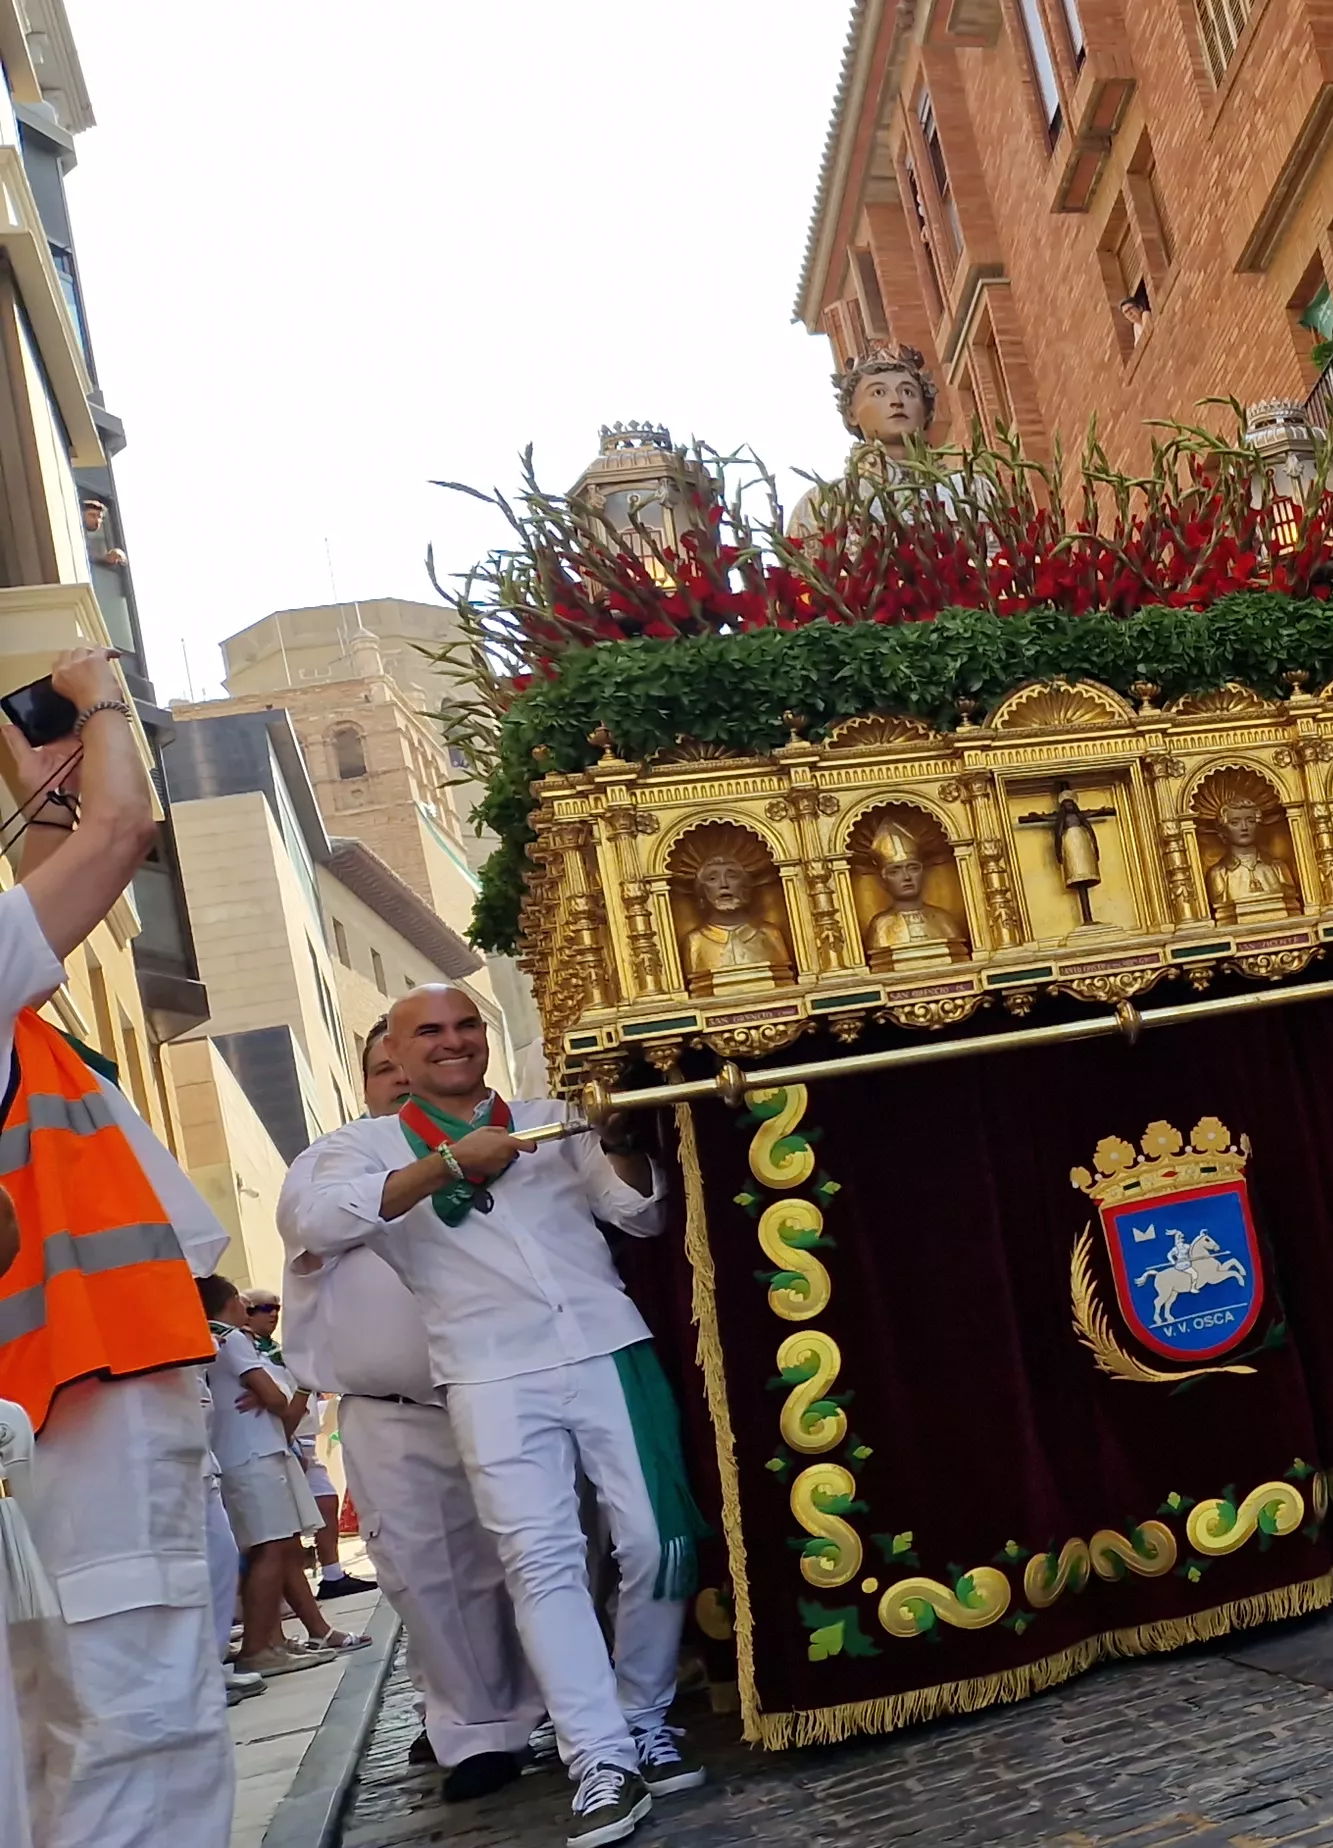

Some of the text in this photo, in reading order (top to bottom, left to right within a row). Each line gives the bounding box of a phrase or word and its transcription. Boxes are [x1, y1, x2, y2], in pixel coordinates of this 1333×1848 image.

[1163, 1311, 1235, 1337] V. V. OSCA
